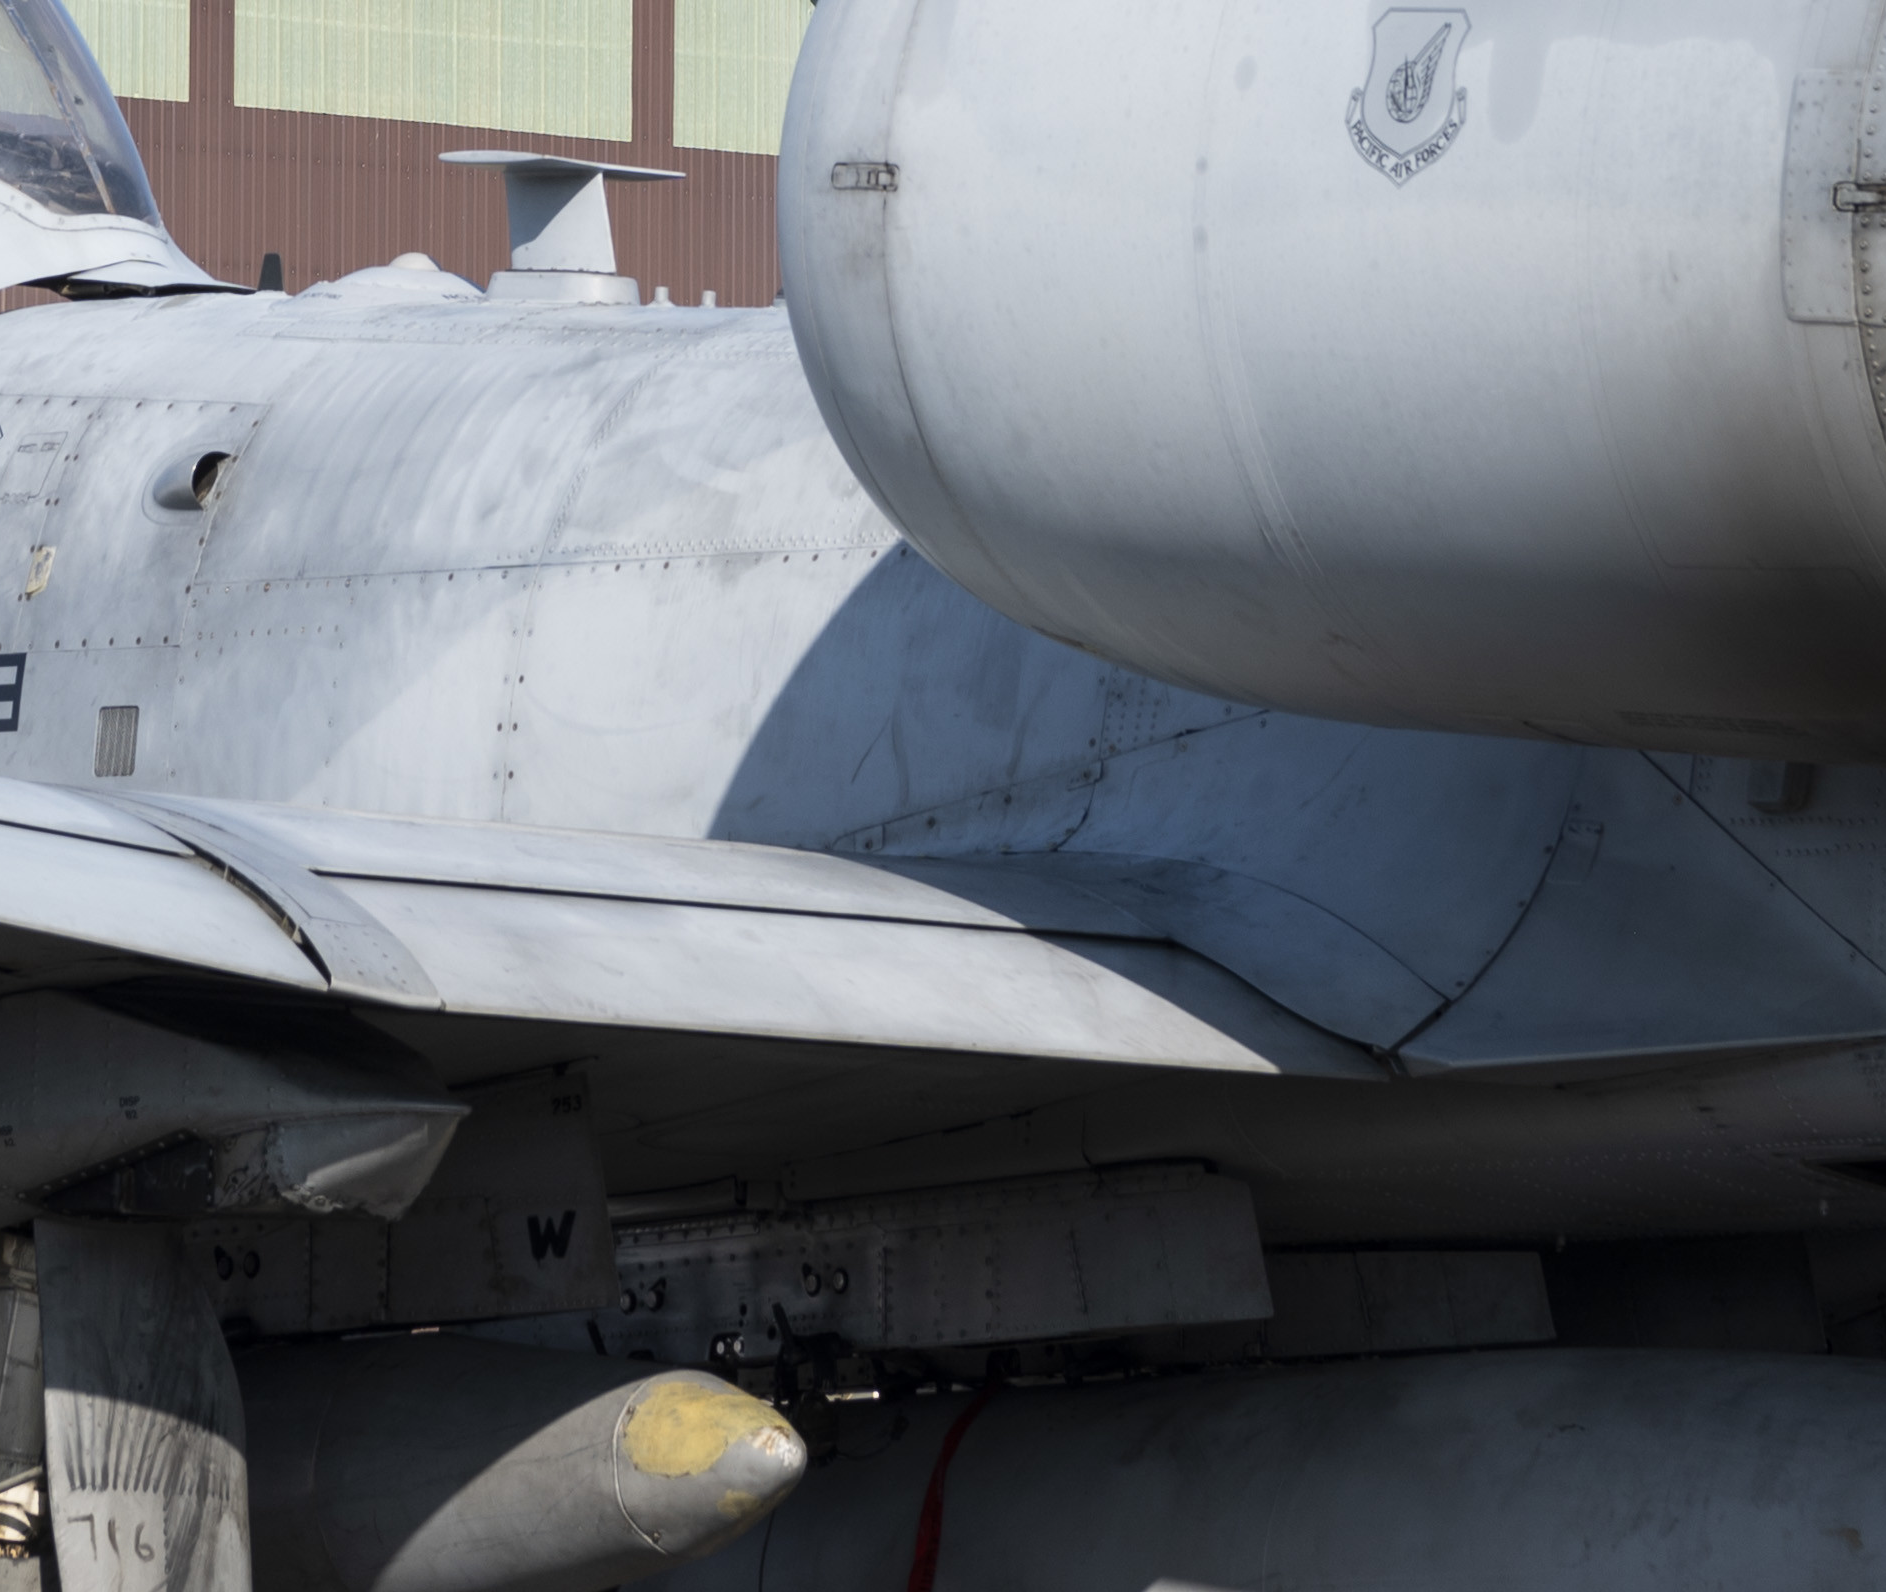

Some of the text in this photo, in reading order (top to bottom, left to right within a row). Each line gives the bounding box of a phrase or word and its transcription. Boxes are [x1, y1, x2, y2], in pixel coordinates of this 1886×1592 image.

[1351, 119, 1458, 179] PACIFIC AIR FORCES
[526, 1210, 577, 1261] W
